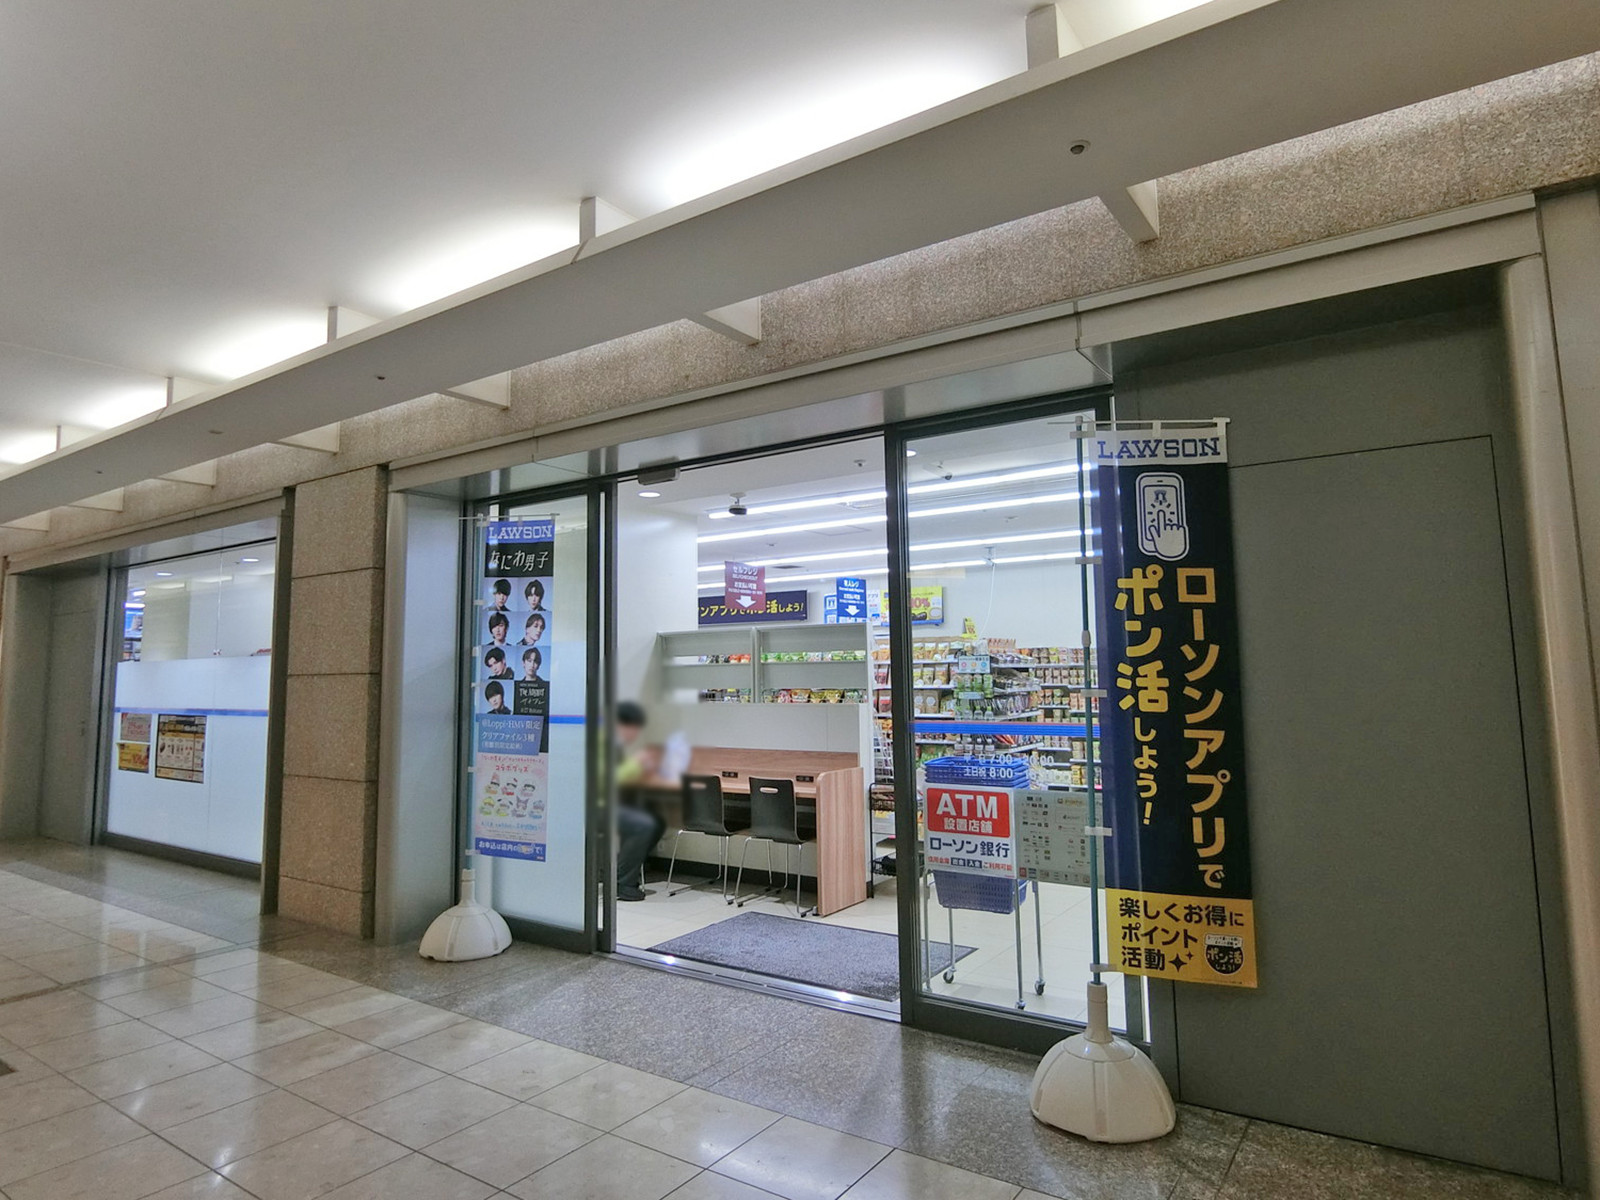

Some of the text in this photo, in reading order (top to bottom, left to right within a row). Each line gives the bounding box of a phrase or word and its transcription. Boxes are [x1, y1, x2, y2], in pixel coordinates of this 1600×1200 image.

[1097, 437, 1221, 459] LAWSON
[488, 525, 553, 539] LAWSON
[490, 550, 549, 572] なにわ男子
[1176, 567, 1231, 889] ローソンアプリで
[989, 767, 1013, 778] 8:00
[936, 793, 998, 819] ATM
[943, 817, 993, 834] 設置店舗
[930, 837, 1010, 858] ローソン銀行
[1119, 897, 1245, 927] 楽しくお得に
[1121, 922, 1198, 949] ポイント
[1121, 946, 1166, 972] 活動
